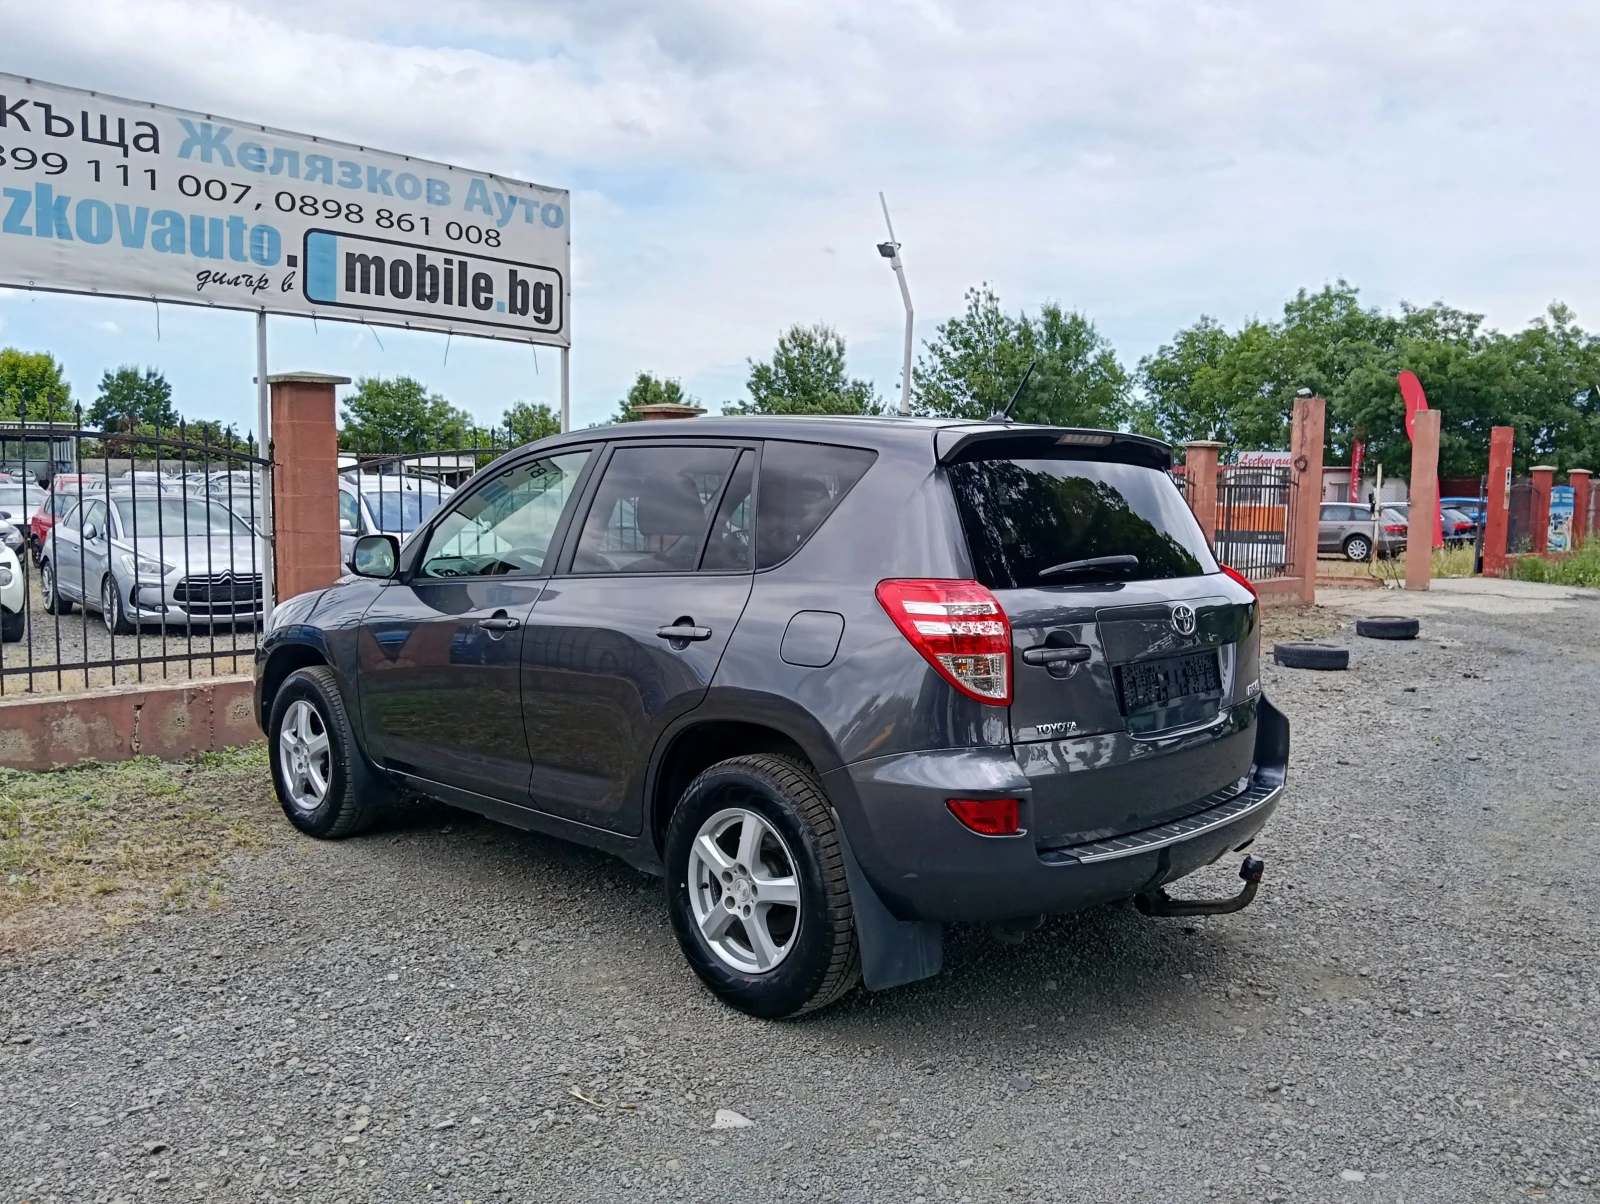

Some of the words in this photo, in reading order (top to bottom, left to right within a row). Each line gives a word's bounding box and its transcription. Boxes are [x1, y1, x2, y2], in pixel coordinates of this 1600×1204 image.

[0, 144, 68, 175] 99
[87, 160, 157, 191] 111
[178, 175, 262, 211] 007,
[274, 191, 364, 223] 0898
[375, 208, 430, 236] 861
[445, 221, 502, 247] 008
[177, 117, 452, 206] Желязков
[463, 178, 565, 229] Ауто
[345, 251, 553, 325] mobile.bg
[1035, 721, 1077, 735] TOYOTA
